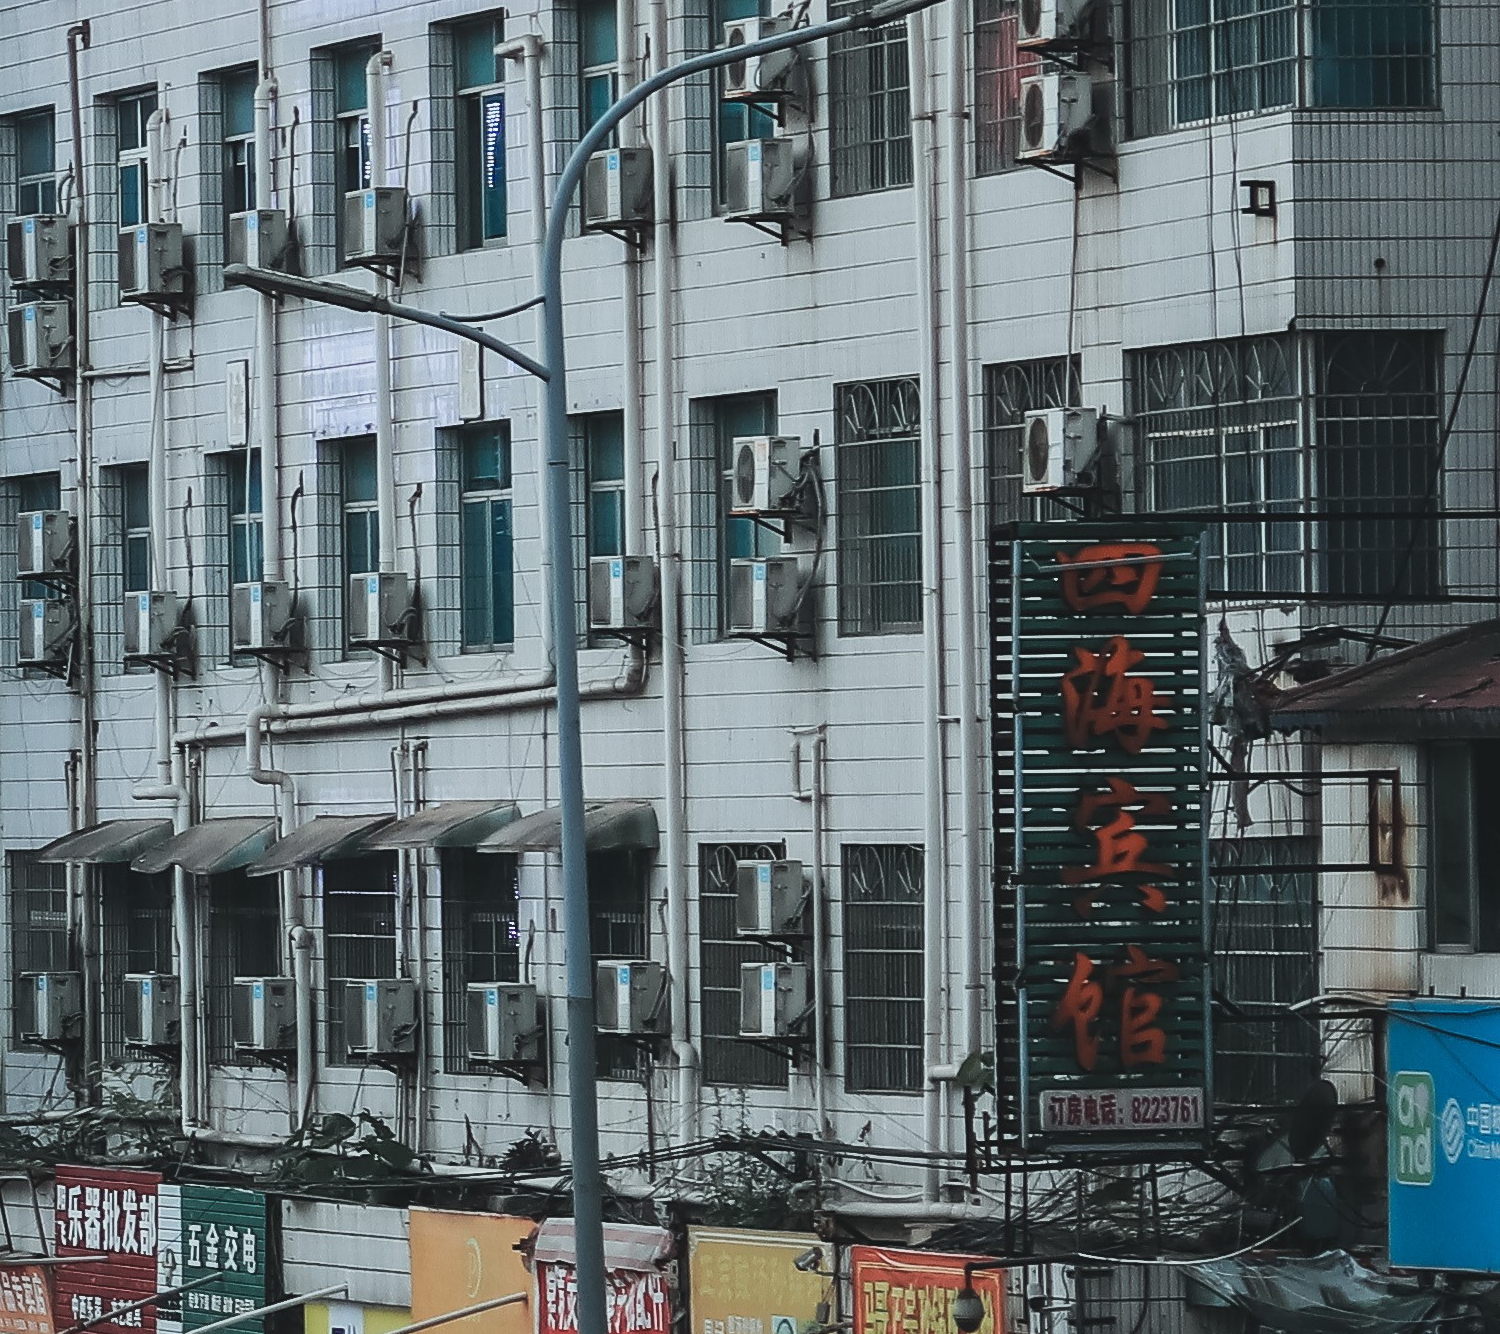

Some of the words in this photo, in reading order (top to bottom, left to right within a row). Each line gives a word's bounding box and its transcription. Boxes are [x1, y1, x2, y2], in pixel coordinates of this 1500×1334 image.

[1053, 543, 1181, 1071] 四海宾馆
[67, 1184, 157, 1257] 乐器批发部
[187, 1223, 257, 1274] 五金交电
